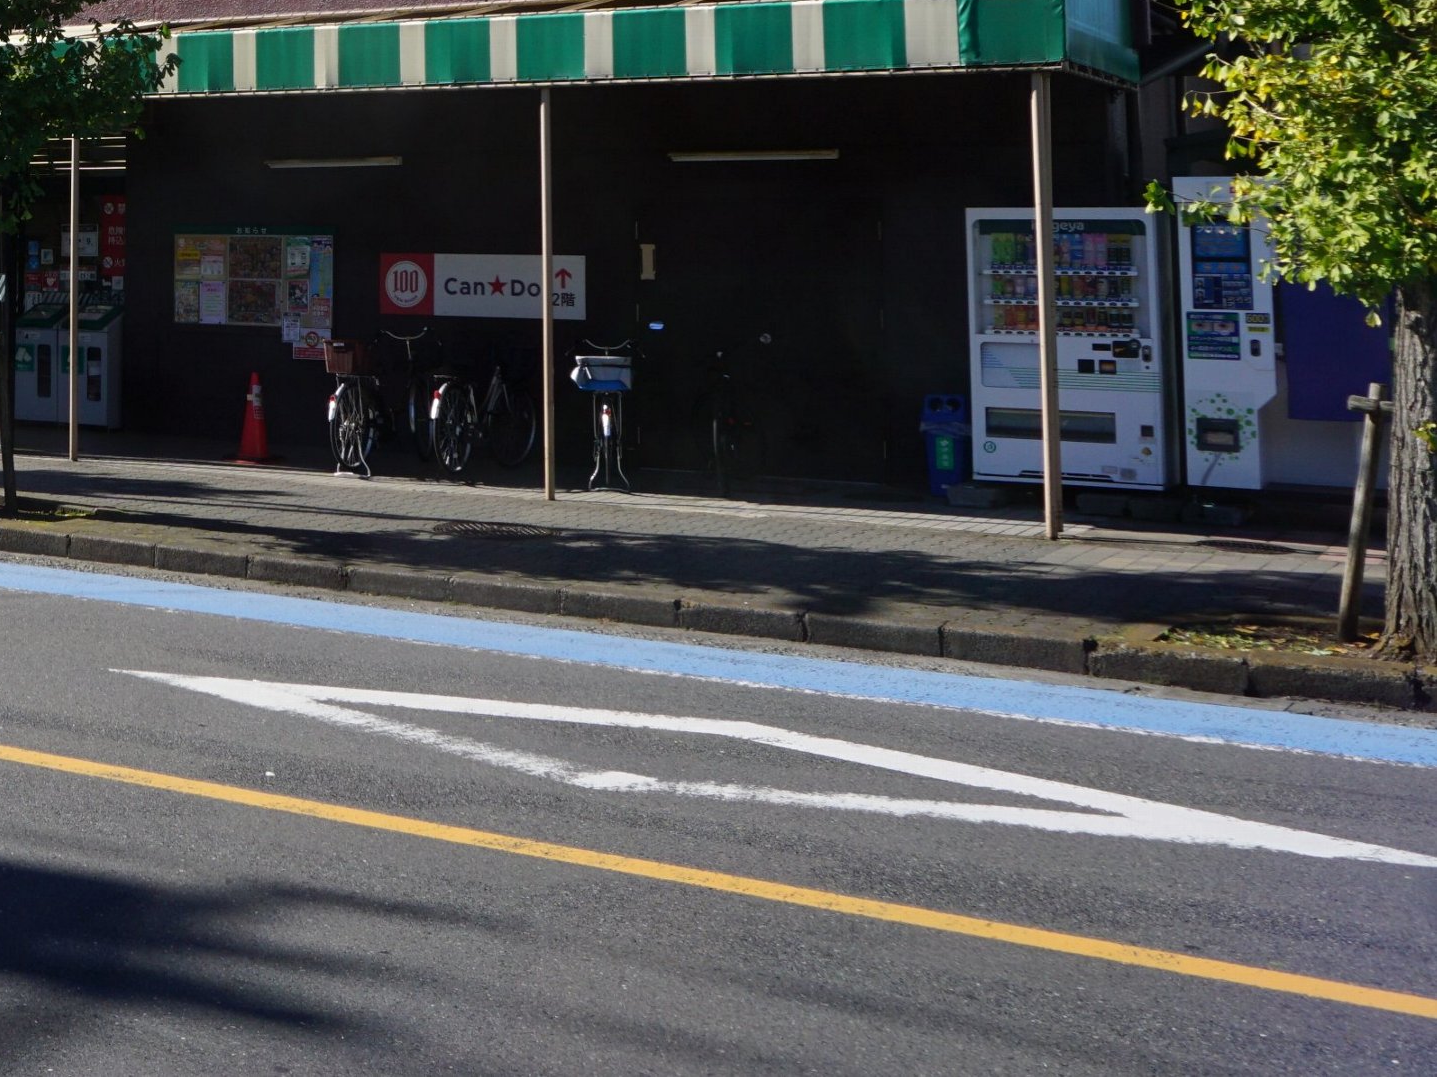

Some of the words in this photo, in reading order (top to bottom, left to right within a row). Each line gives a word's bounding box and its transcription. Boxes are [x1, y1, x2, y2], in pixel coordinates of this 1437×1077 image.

[108, 226, 126, 235] 危険
[235, 227, 267, 235] お知らせ
[392, 269, 419, 293] 100
[444, 277, 485, 295] Can
[510, 279, 541, 297] Do
[552, 292, 575, 307] 2階
